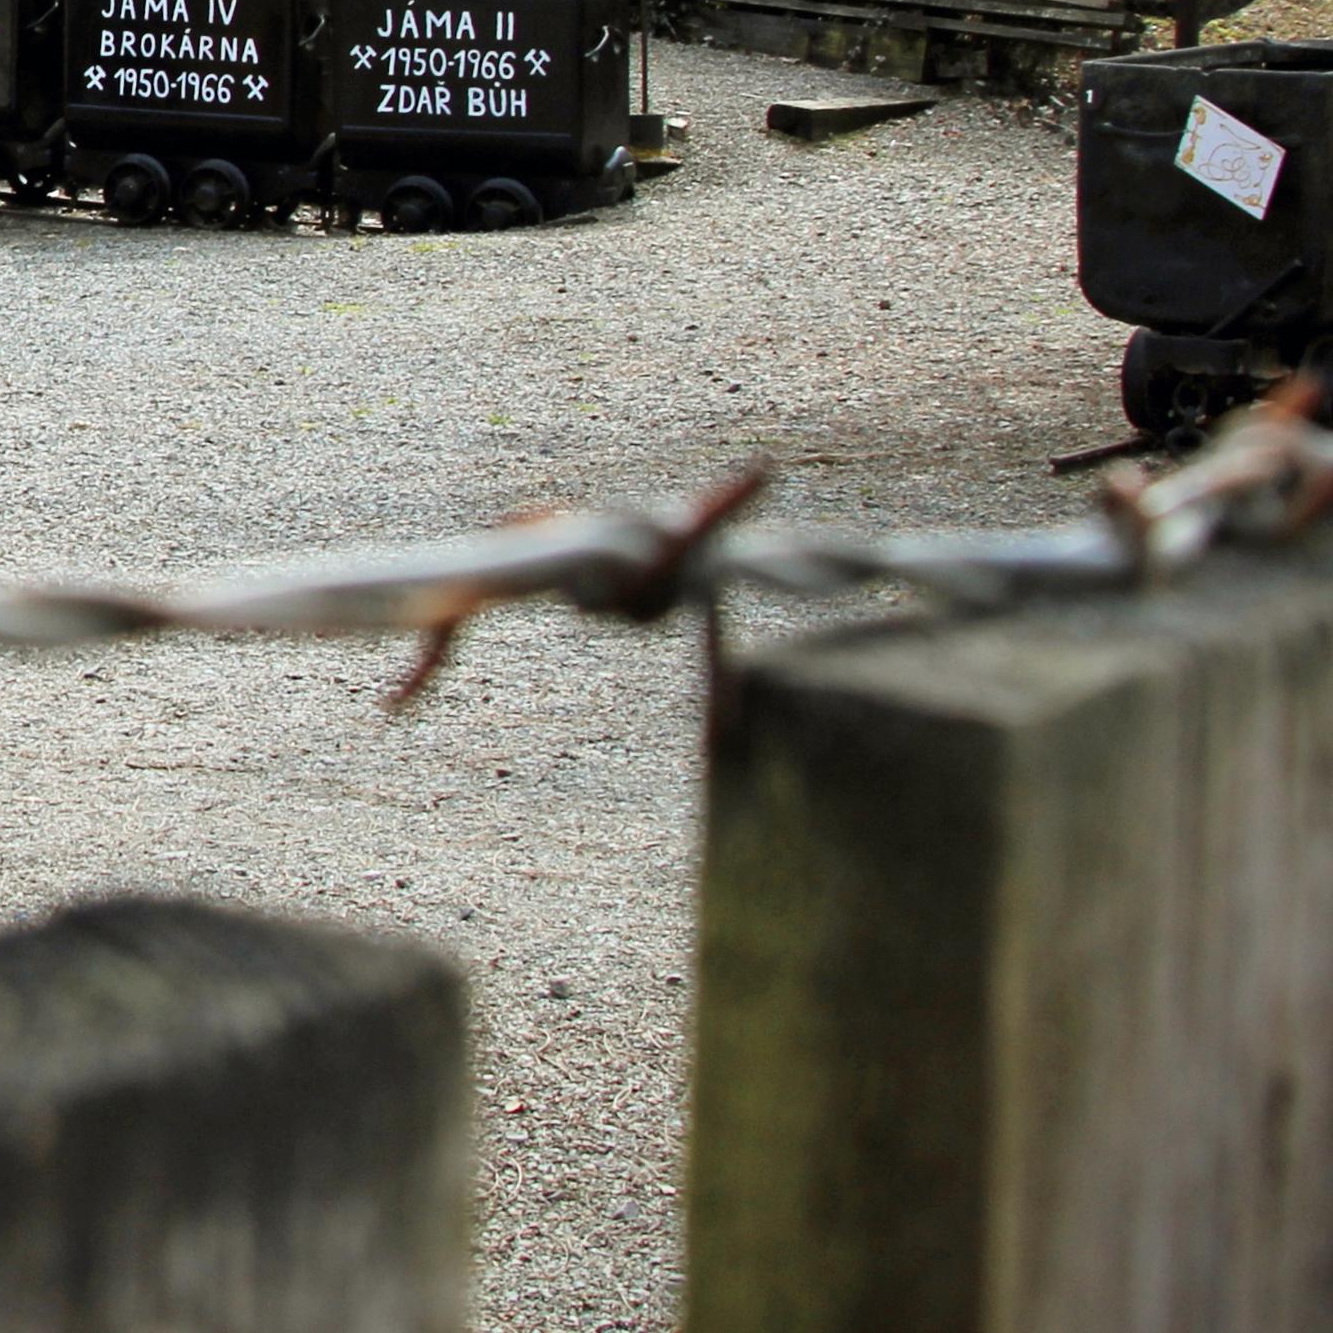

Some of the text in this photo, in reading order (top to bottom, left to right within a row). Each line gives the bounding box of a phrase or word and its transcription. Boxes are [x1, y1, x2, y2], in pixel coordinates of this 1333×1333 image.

[376, 0, 515, 41] JÁMA II
[100, 28, 259, 64] BROKÁRNA
[380, 46, 517, 80] 1950-1966
[113, 68, 235, 104] 1950-1966
[376, 80, 527, 117] ZDAŘ BŮH
[1085, 89, 1094, 103] 1
